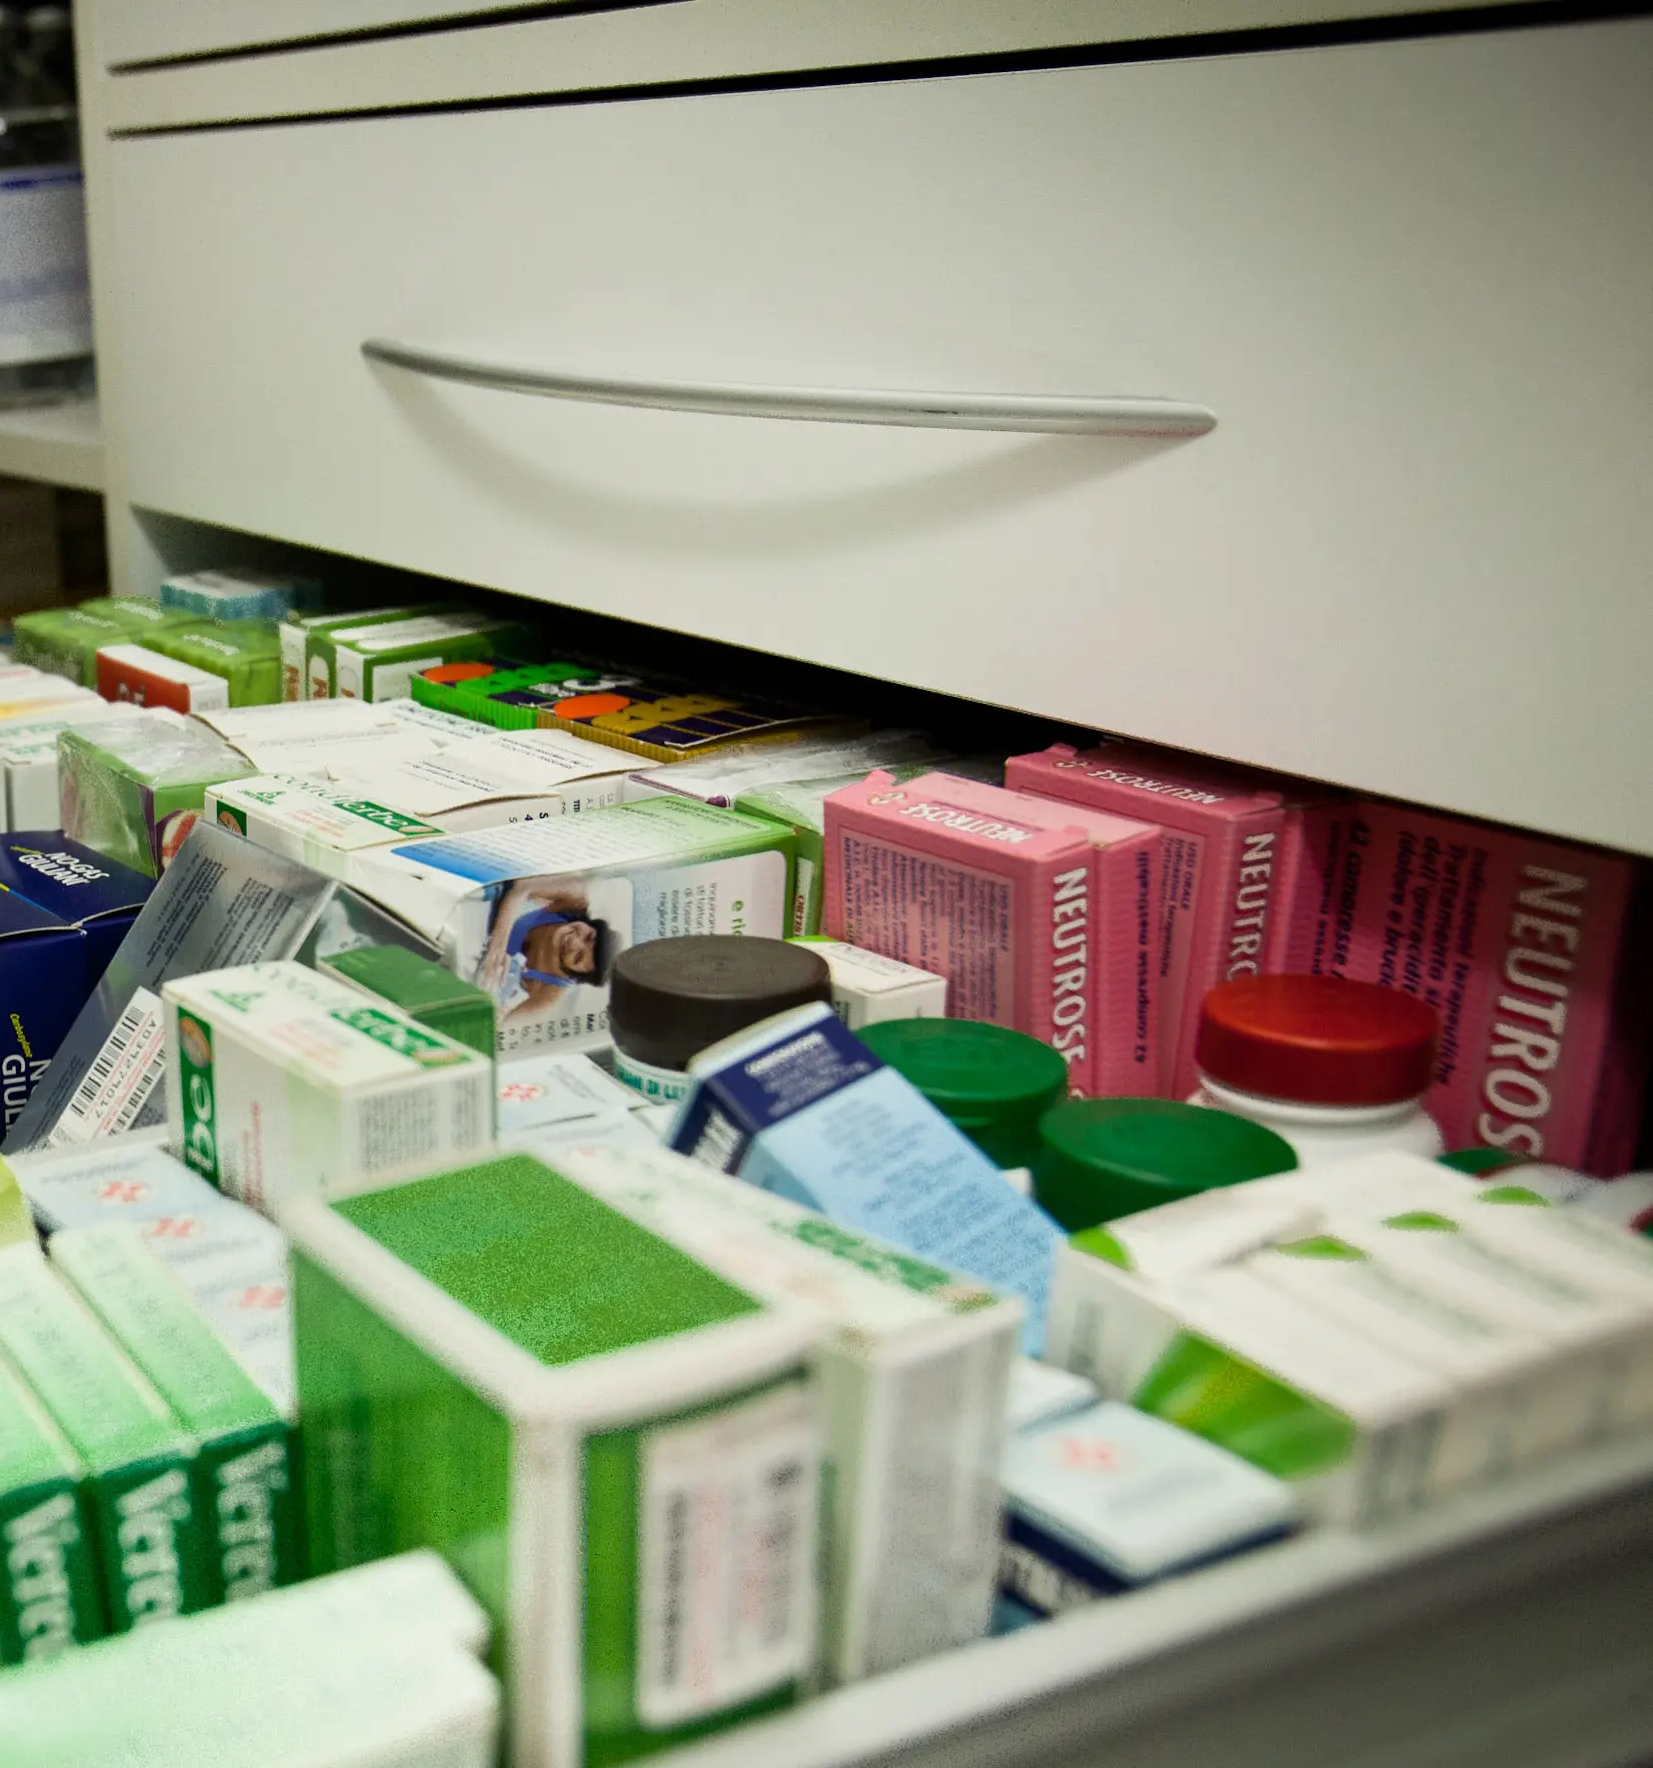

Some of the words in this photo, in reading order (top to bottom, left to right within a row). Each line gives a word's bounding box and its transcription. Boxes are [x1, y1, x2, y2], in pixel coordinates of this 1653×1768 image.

[1088, 769, 1227, 804] NEUTROSE
[898, 803, 1033, 845] NEUTROSE
[18, 854, 90, 886] GIULIANI
[1052, 868, 1088, 1064] NEUTROSE
[1477, 862, 1589, 1157] NEUTROS
[2, 1054, 26, 1132] GIUL
